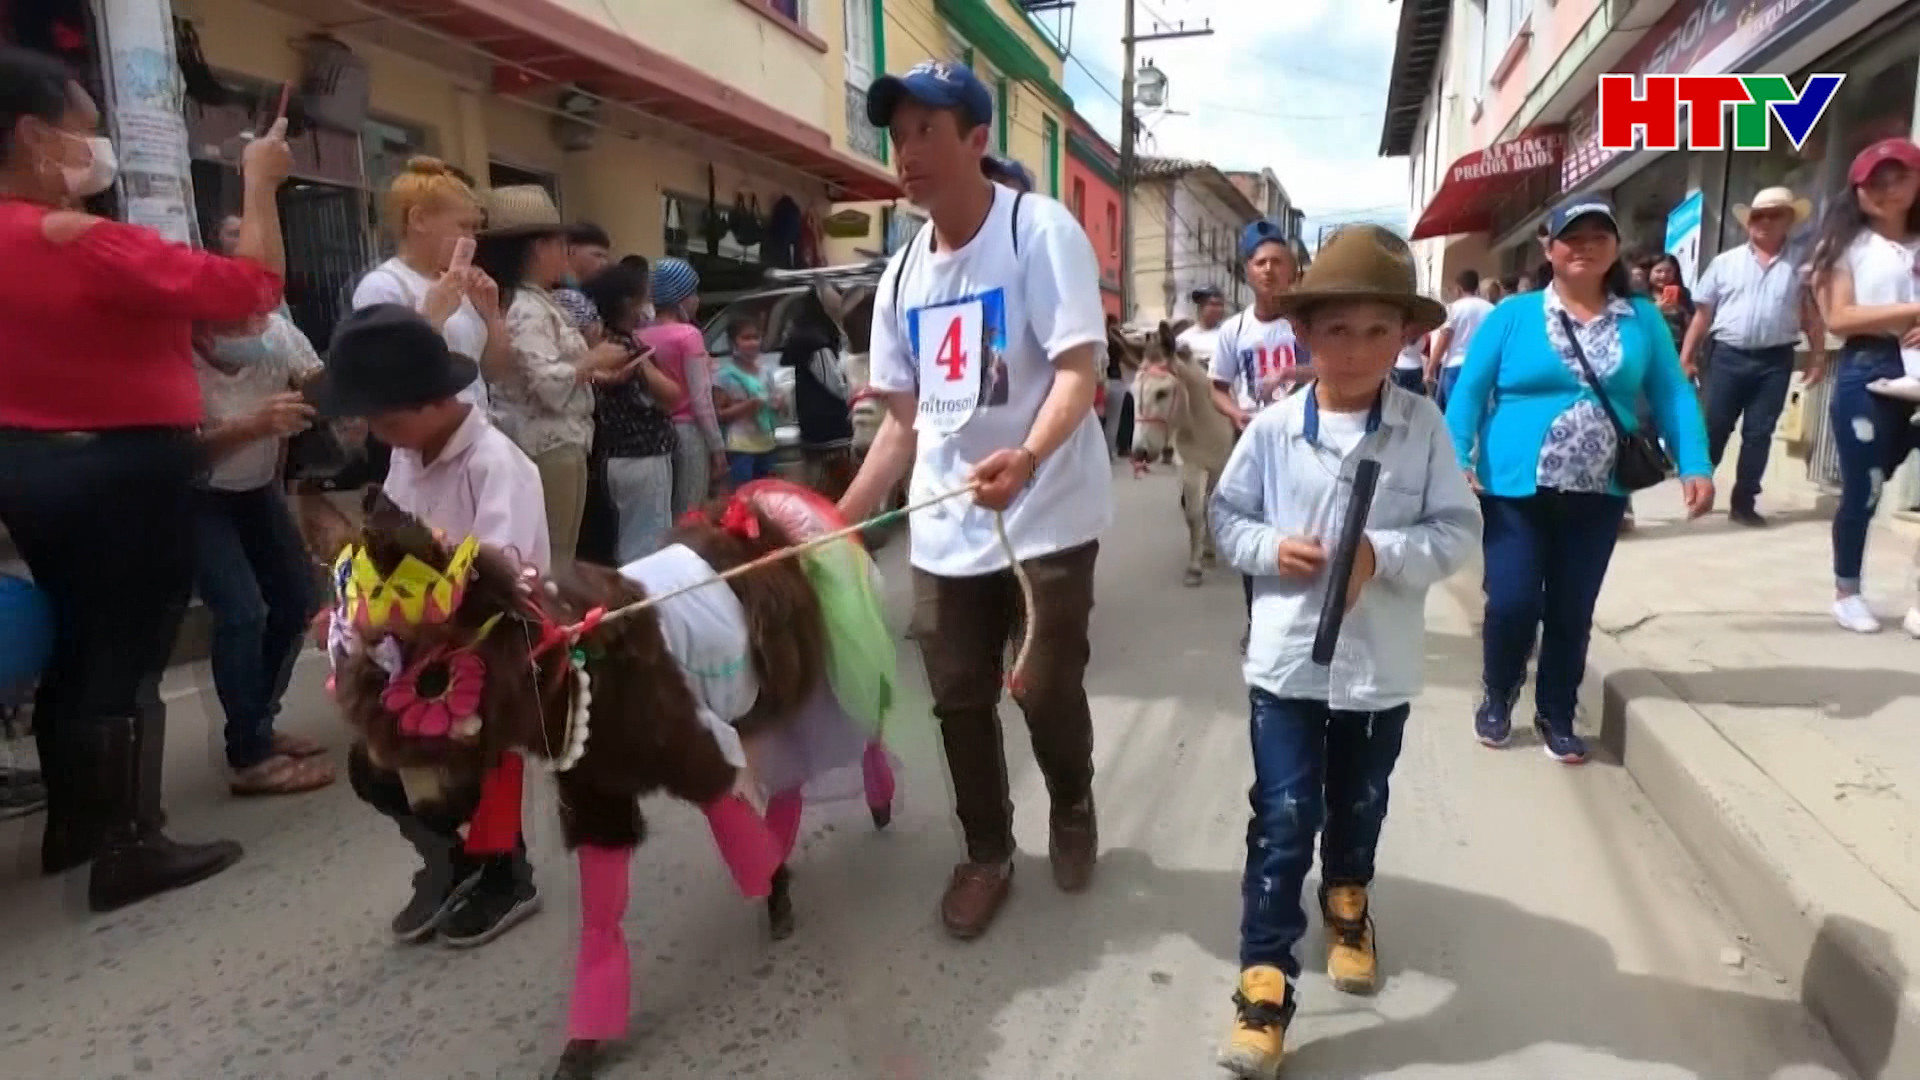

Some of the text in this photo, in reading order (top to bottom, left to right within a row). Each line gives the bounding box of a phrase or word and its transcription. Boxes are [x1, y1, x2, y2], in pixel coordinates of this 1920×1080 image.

[1454, 149, 1554, 181] PRECIOS BAJOS
[936, 316, 967, 382] 4
[1257, 344, 1294, 377] 10
